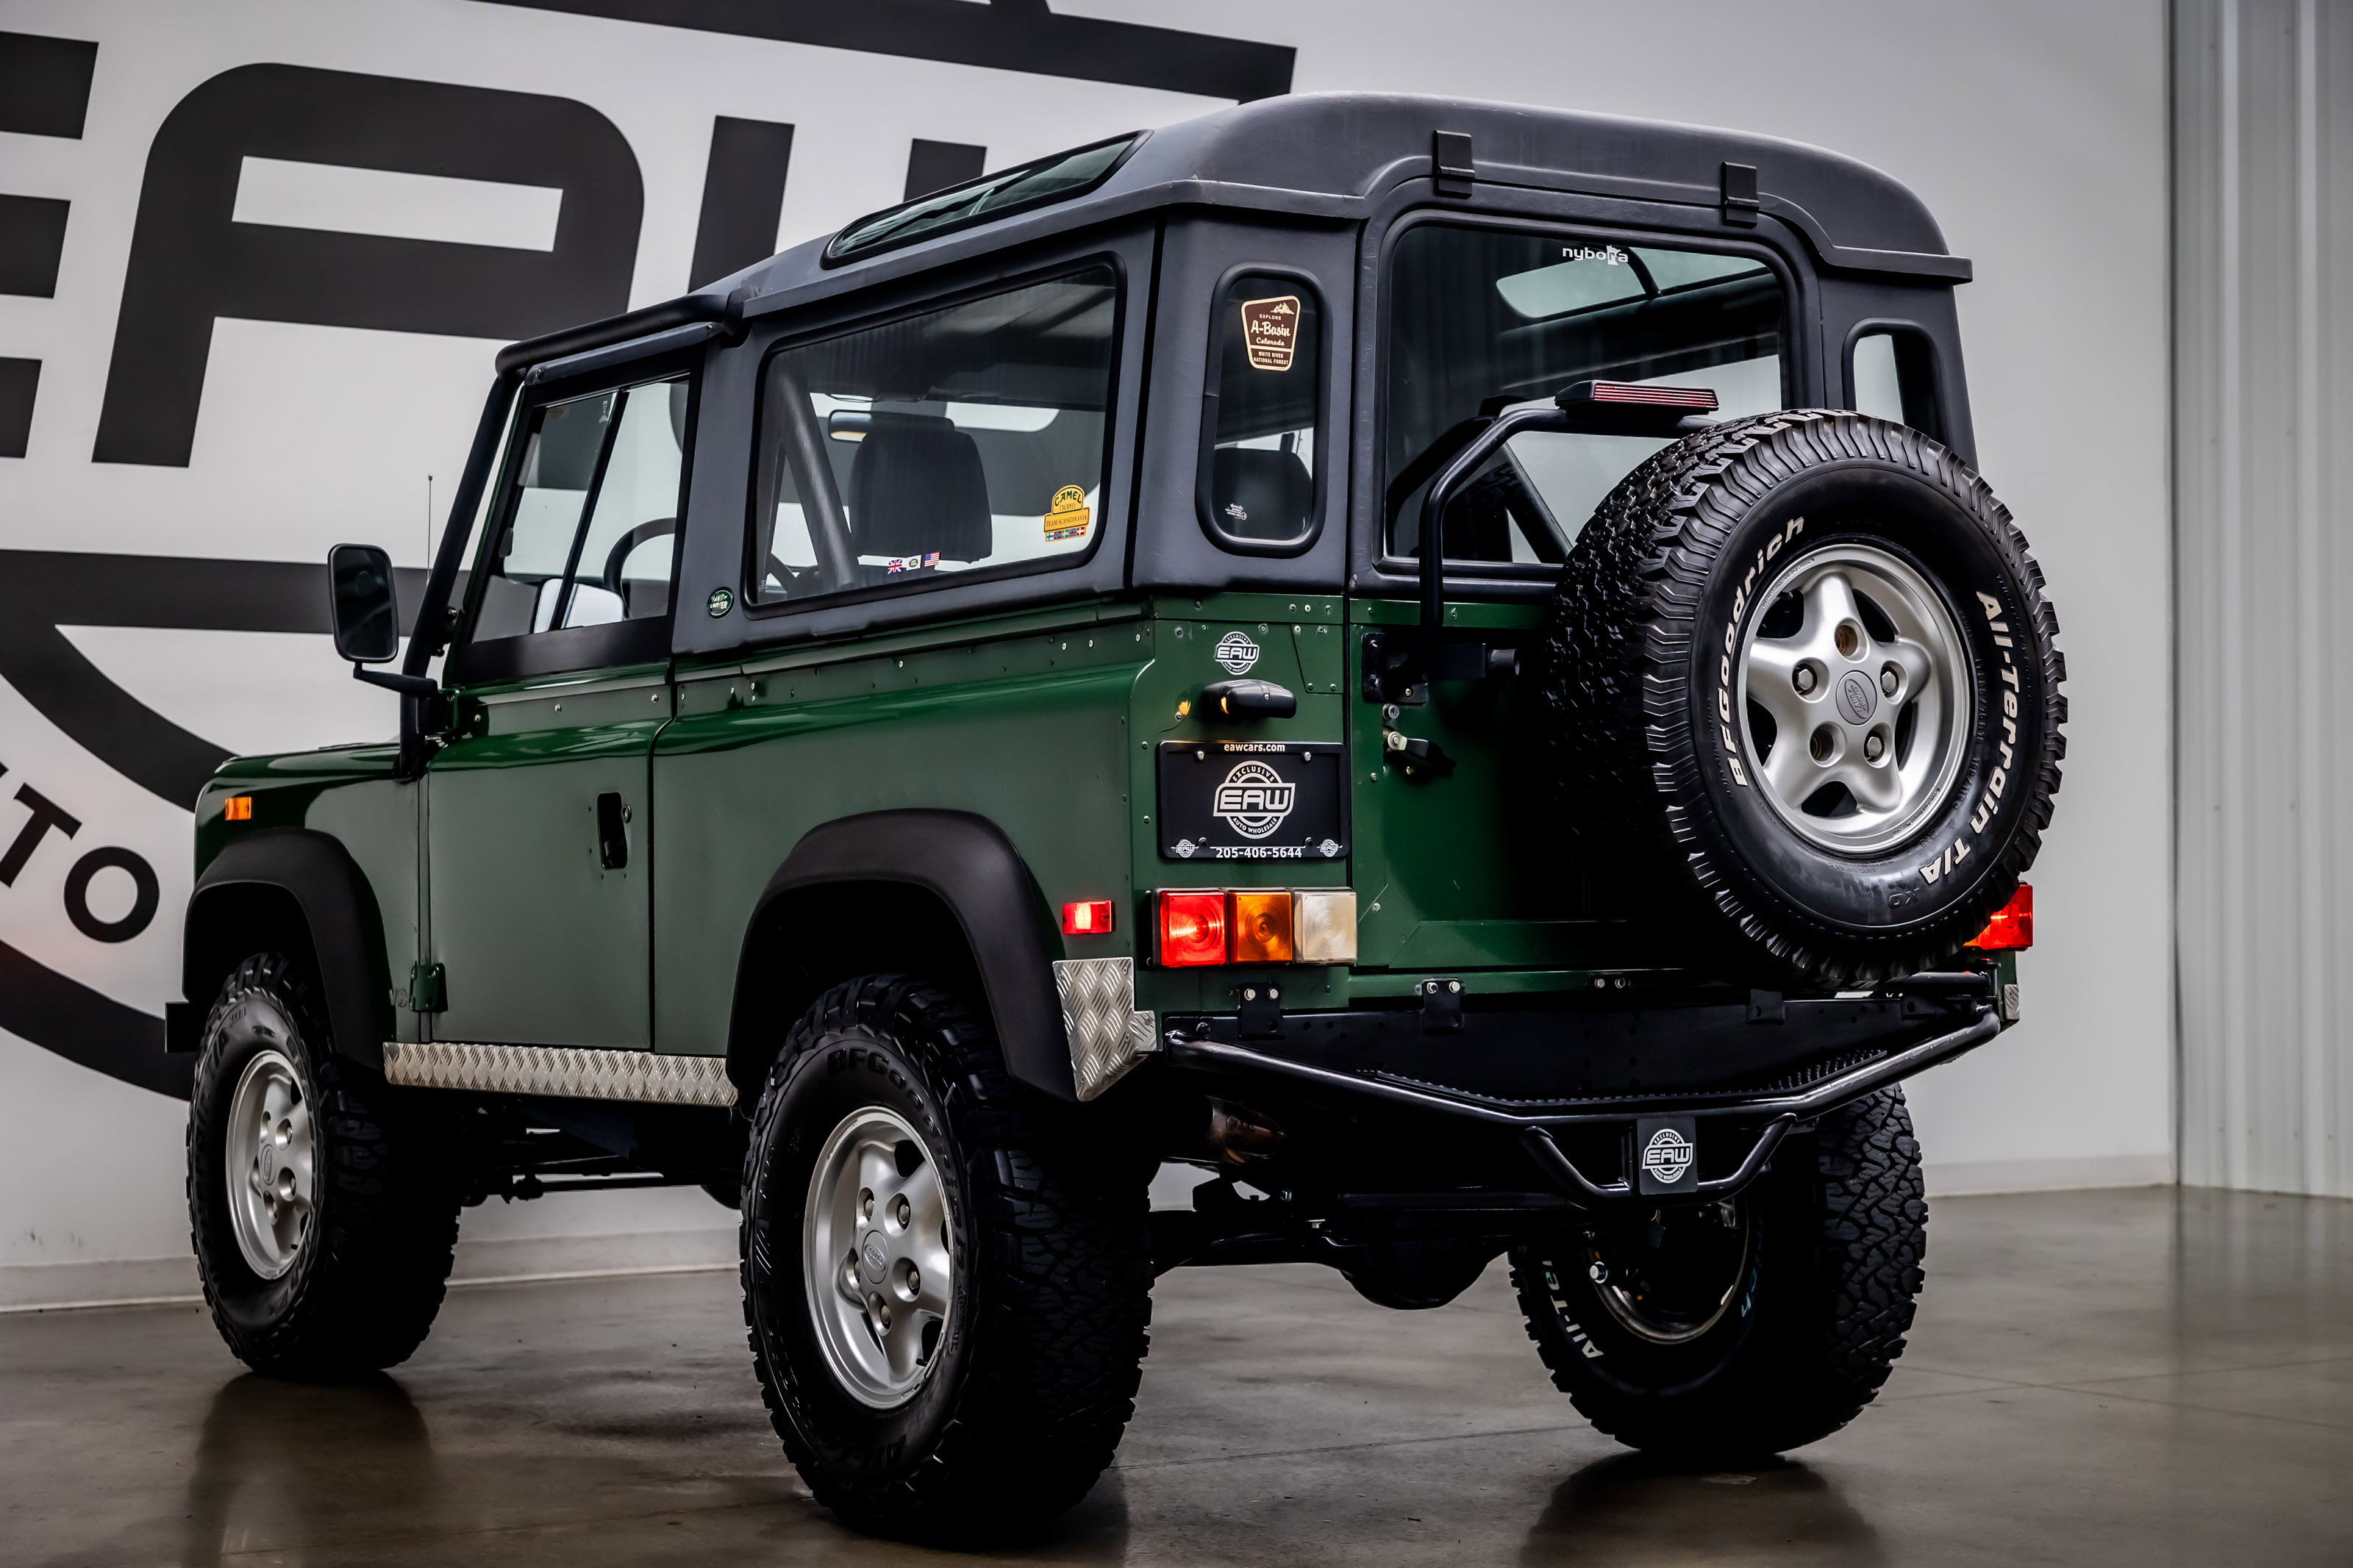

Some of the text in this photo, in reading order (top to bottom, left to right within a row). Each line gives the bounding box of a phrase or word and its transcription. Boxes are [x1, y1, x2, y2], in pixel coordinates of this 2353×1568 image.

[1250, 320, 1290, 337] A-Basin
[1256, 337, 1285, 346] Colorado
[1054, 490, 1082, 506] CAMEL
[1060, 503, 1076, 511] TROPHY
[1046, 519, 1057, 527] TEAM
[1225, 634, 1249, 644] EXCLUSIVE
[1217, 646, 1257, 659] EAW
[1718, 517, 1804, 787] BFGoodrich
[1224, 662, 1232, 670] AUTO
[1970, 591, 2020, 834] All-Terrain
[1224, 743, 1285, 752] eawcars.com
[1232, 765, 1275, 782] EXCLUSIVE
[1219, 790, 1289, 810] EAW
[1232, 817, 1278, 834] AUTO WHOLESALE
[1215, 848, 1302, 858] 205-406-5644
[1654, 1132, 1681, 1145] EXCLUSIVE
[1646, 1148, 1690, 1164] EAW
